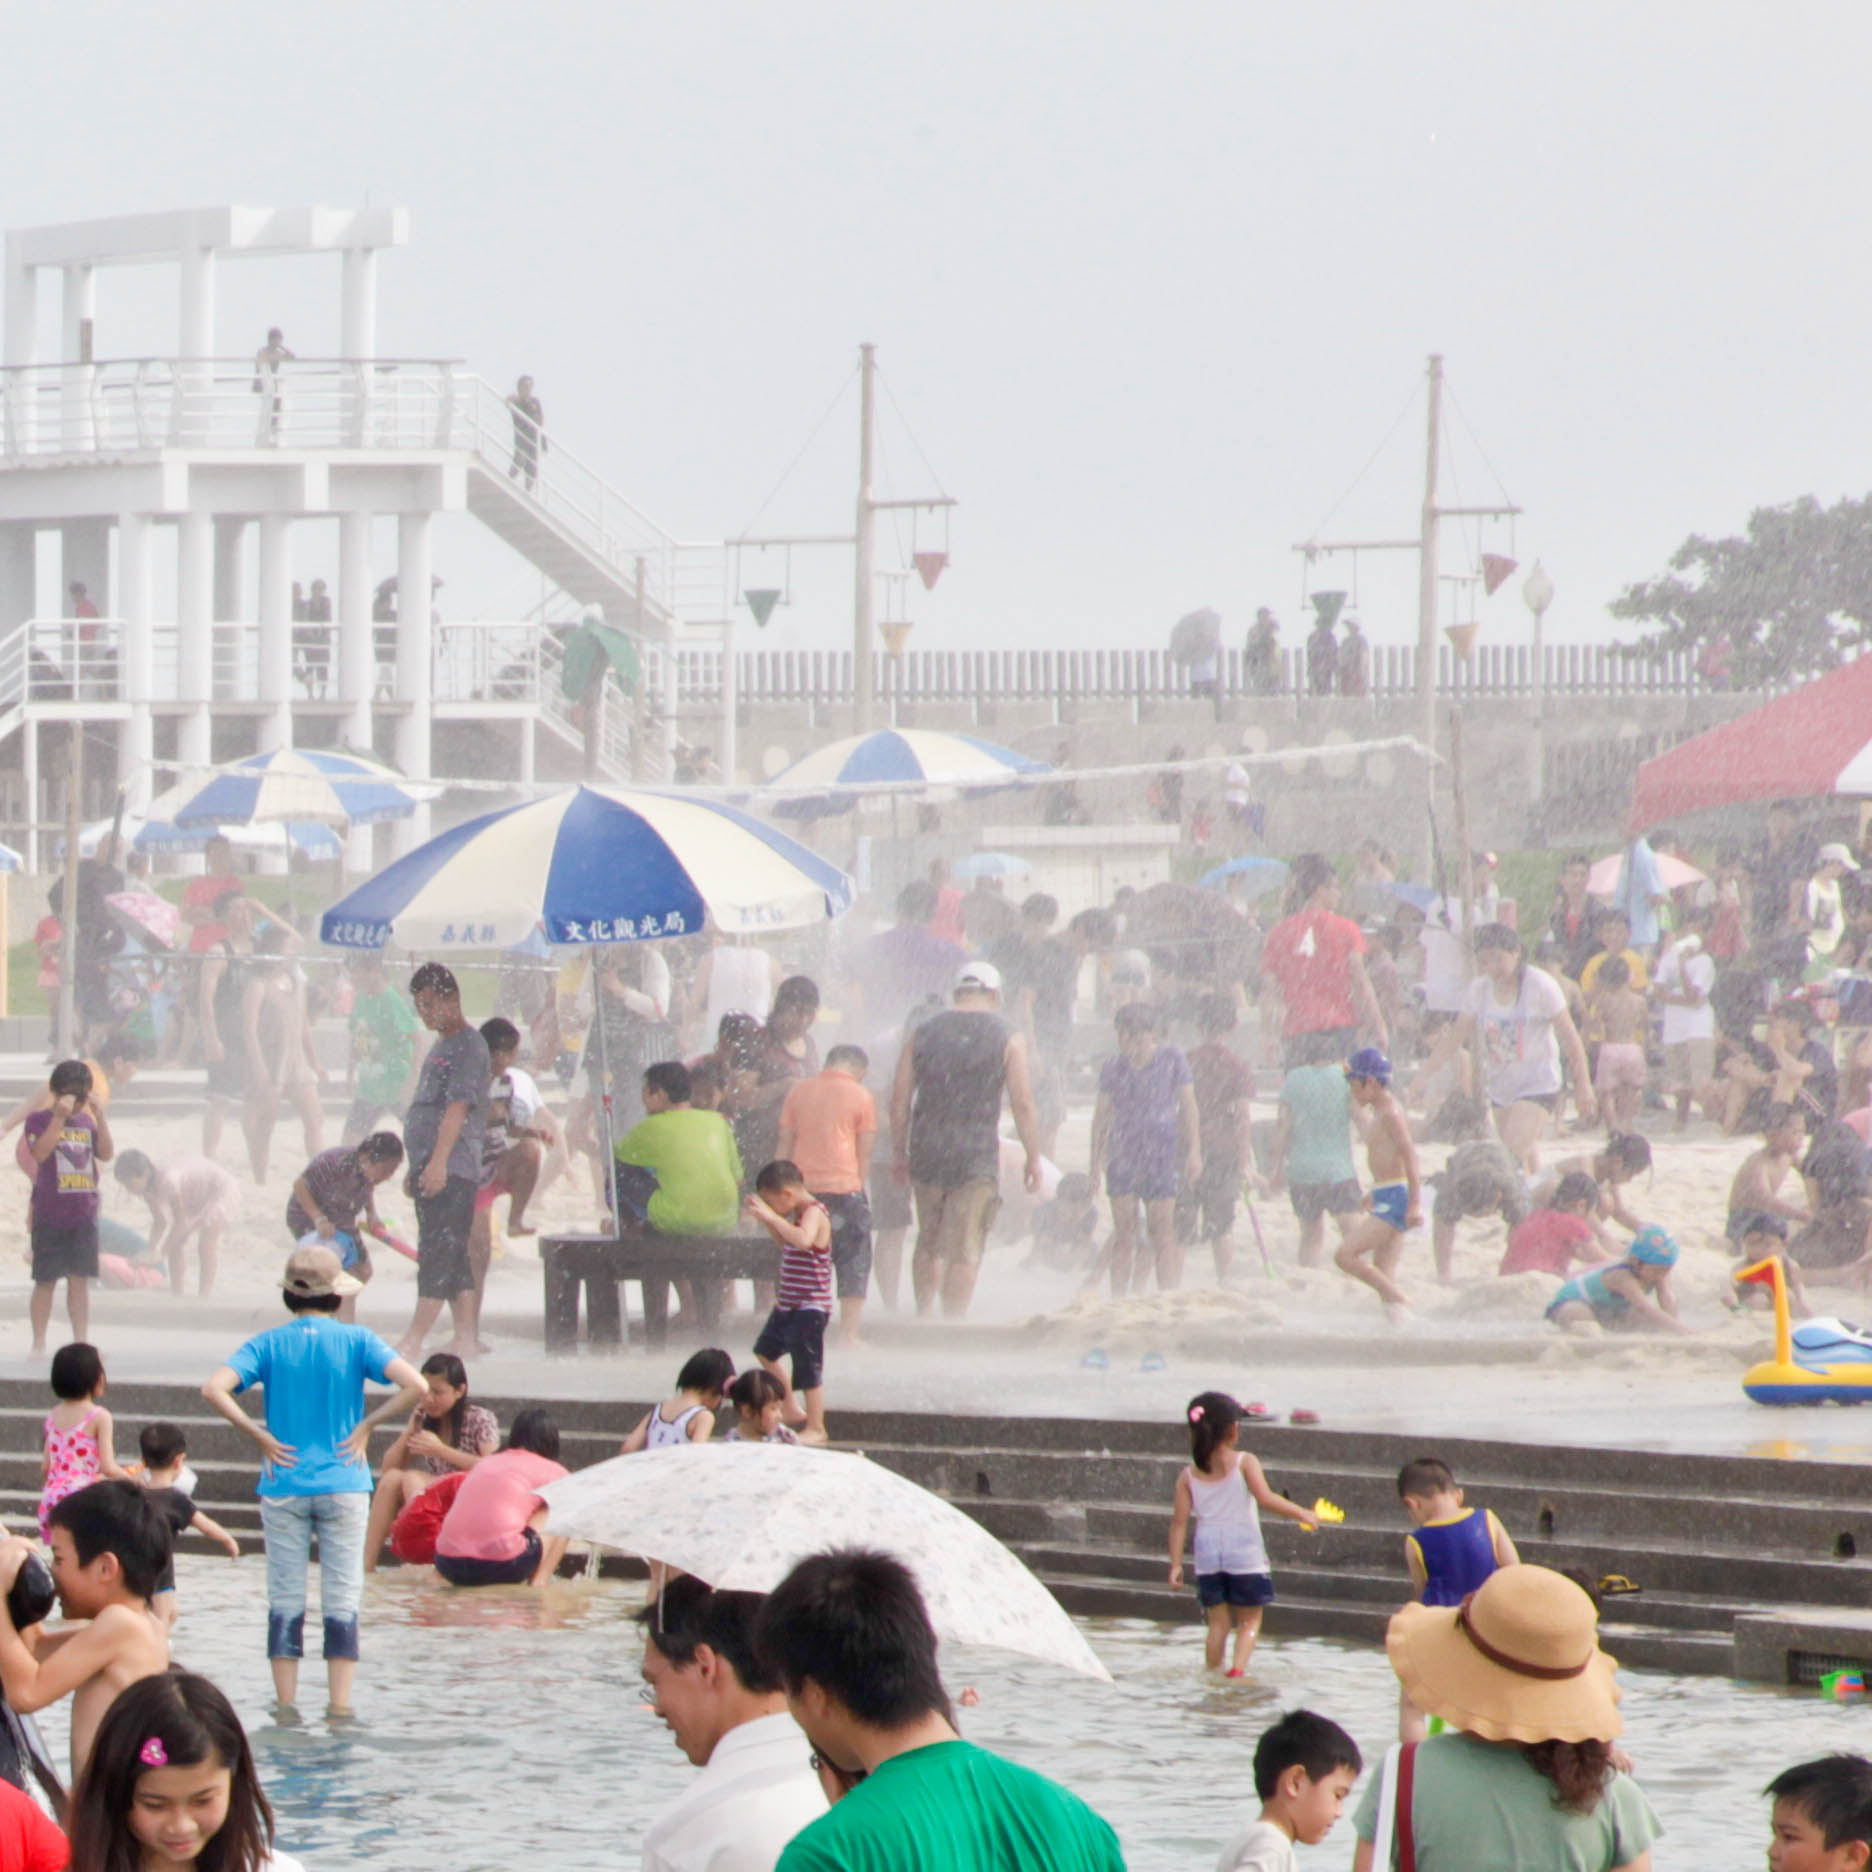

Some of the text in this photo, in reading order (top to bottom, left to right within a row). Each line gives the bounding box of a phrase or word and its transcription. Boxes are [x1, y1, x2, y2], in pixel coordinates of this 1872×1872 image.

[563, 910, 685, 941] 文化觀光局
